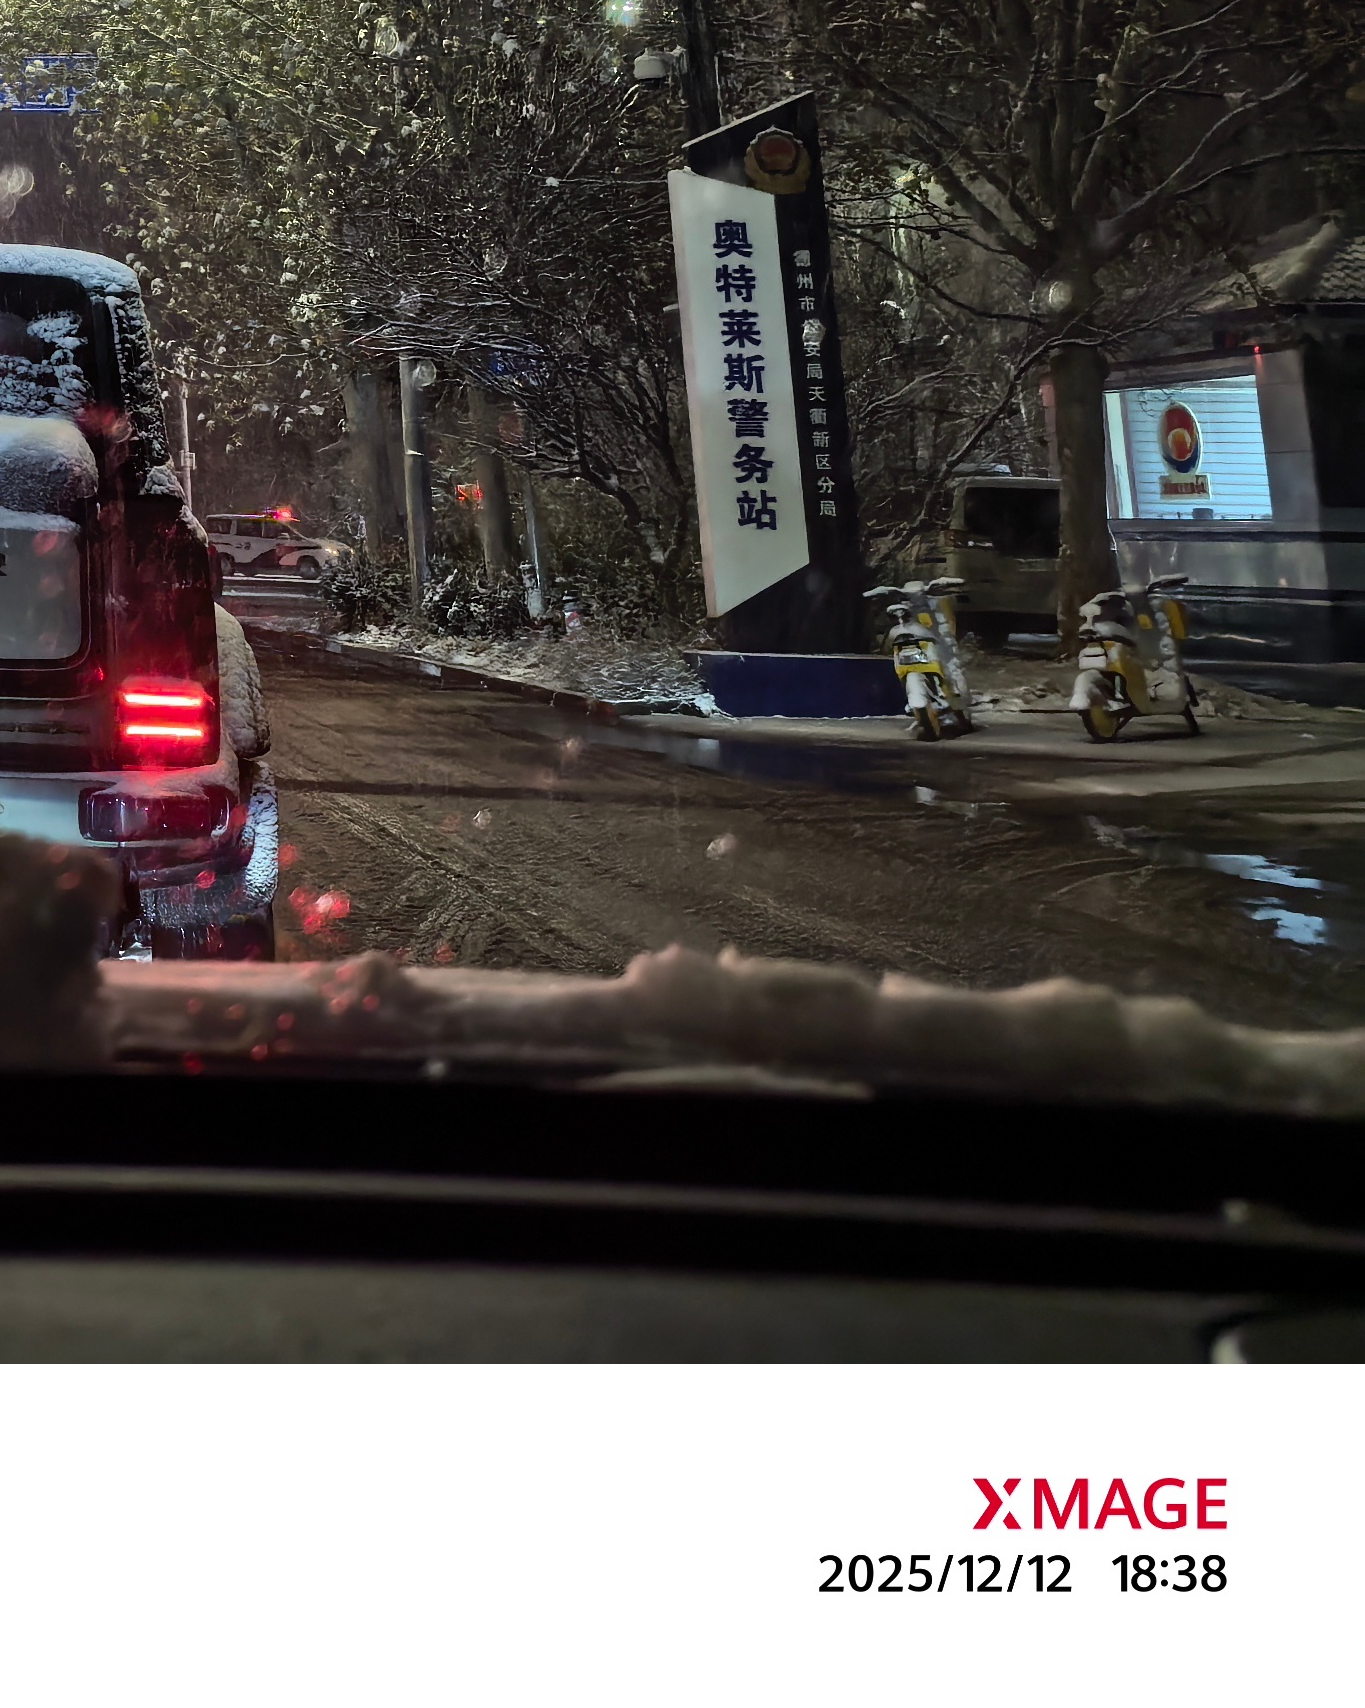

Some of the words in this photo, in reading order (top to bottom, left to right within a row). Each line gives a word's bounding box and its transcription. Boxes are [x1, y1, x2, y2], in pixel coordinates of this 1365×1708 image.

[713, 219, 777, 531] 奥特莱斯警务站
